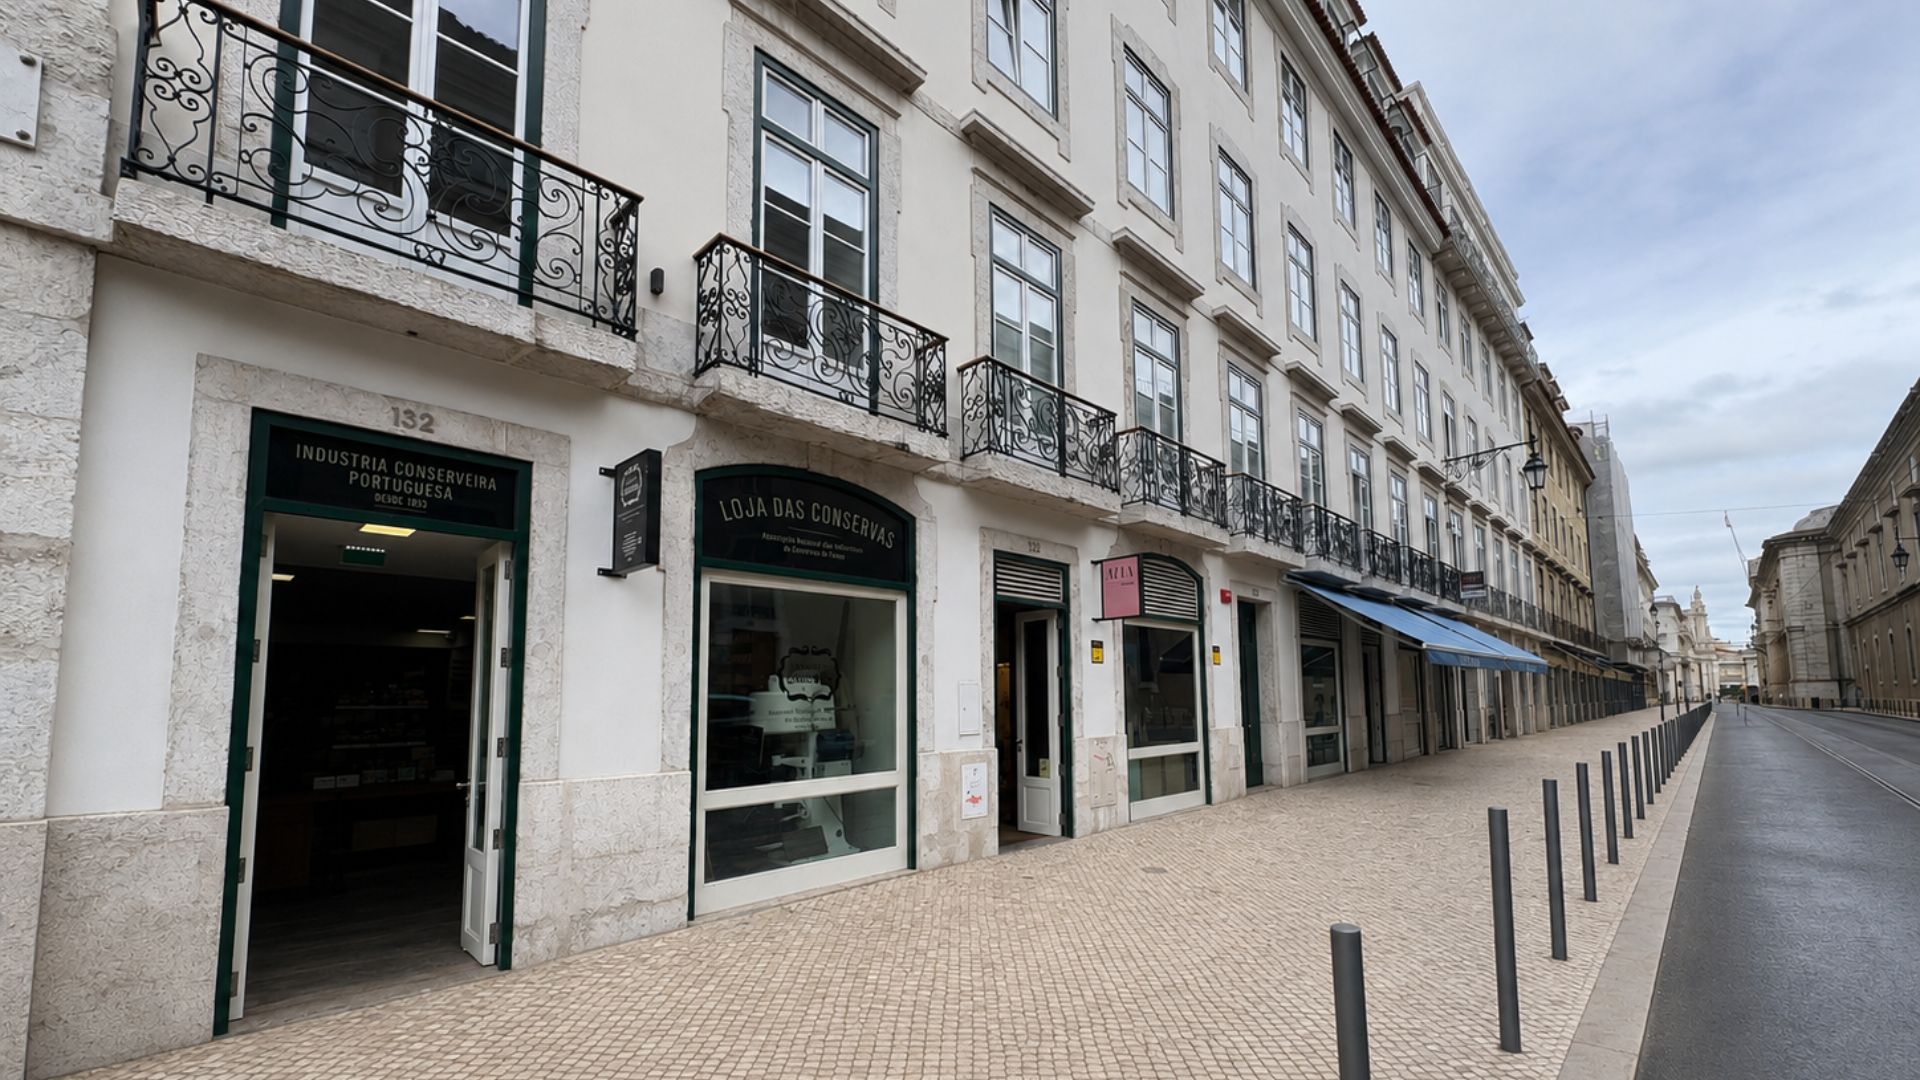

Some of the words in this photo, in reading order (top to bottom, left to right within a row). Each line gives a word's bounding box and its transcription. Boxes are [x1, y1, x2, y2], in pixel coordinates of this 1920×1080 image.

[391, 406, 435, 434] 132
[296, 443, 388, 474] INDUSTRIA
[394, 461, 497, 491] CONSERVEIRA
[349, 470, 453, 500] PORTUGUESA
[719, 496, 768, 522] LOJA
[773, 496, 805, 520] DAS
[811, 502, 896, 549] CONSERVAS
